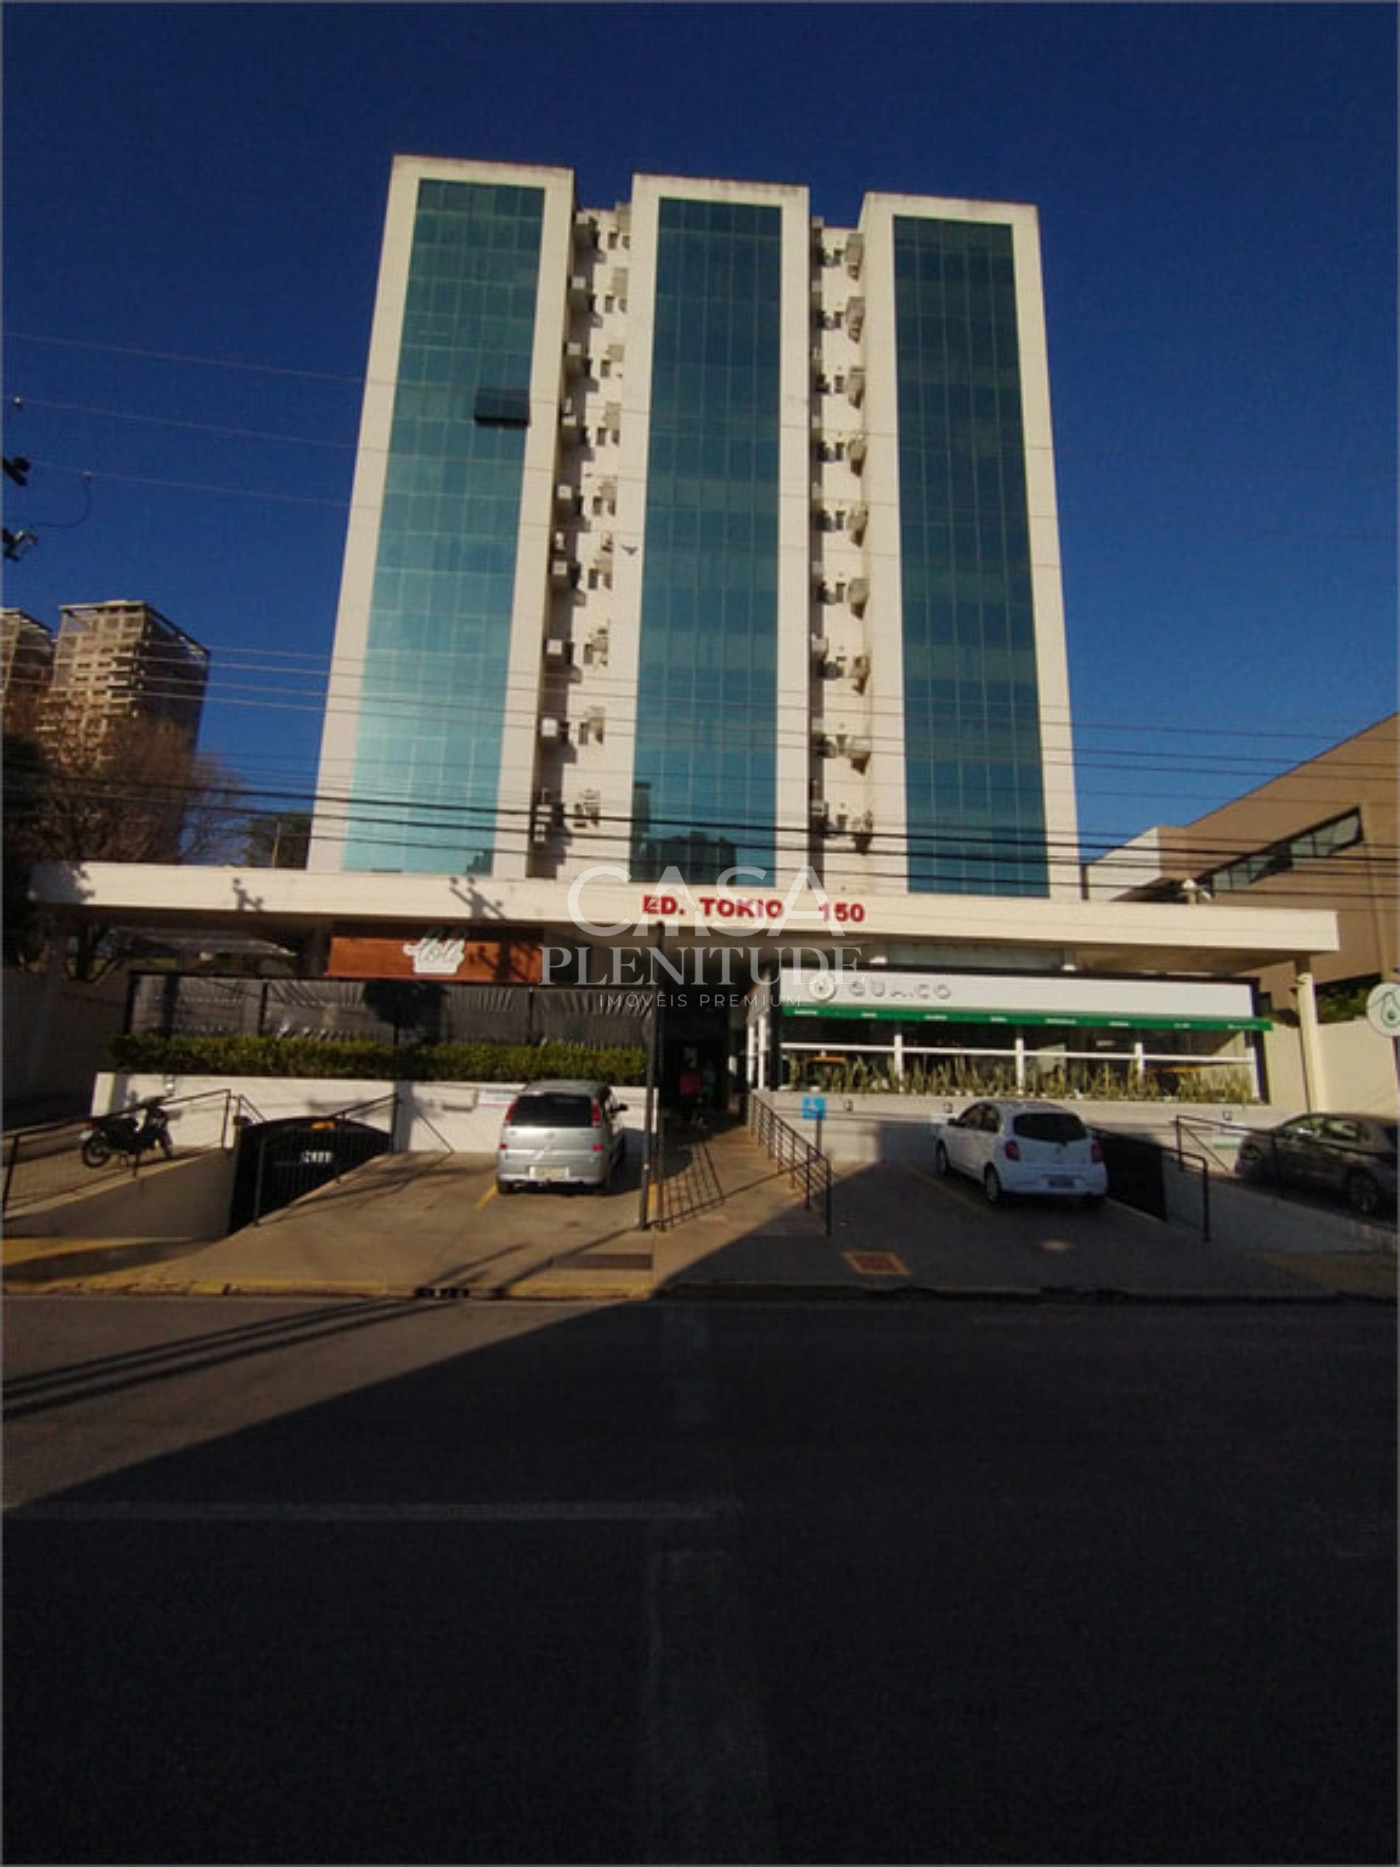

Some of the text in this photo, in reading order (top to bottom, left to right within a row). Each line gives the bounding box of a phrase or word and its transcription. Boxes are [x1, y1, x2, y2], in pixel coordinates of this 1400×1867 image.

[642, 895, 866, 923] ED. TOKIO 150
